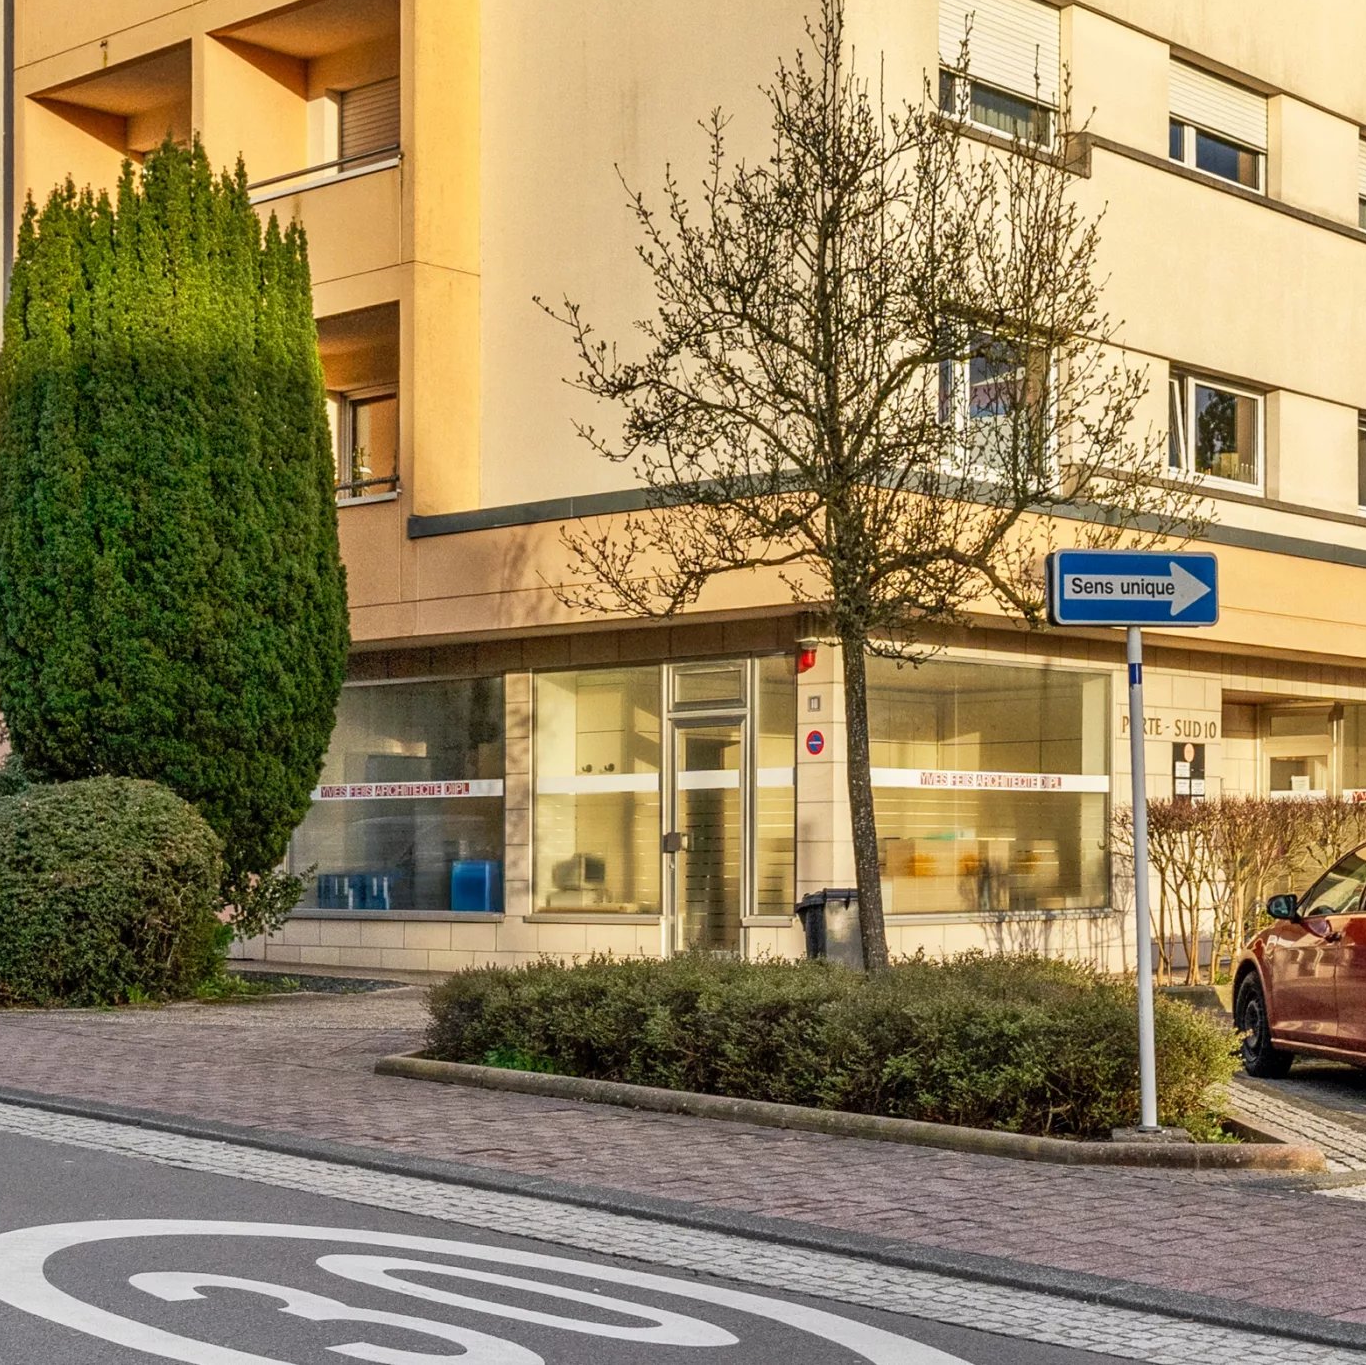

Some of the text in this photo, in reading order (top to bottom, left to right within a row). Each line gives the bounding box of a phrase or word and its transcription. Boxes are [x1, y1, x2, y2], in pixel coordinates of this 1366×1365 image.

[1071, 577, 1175, 598] Sens unique
[1122, 715, 1163, 736] PRTE
[320, 785, 348, 798] YVES
[375, 782, 442, 797] ARCHITECTE
[126, 1253, 741, 1365] 30
